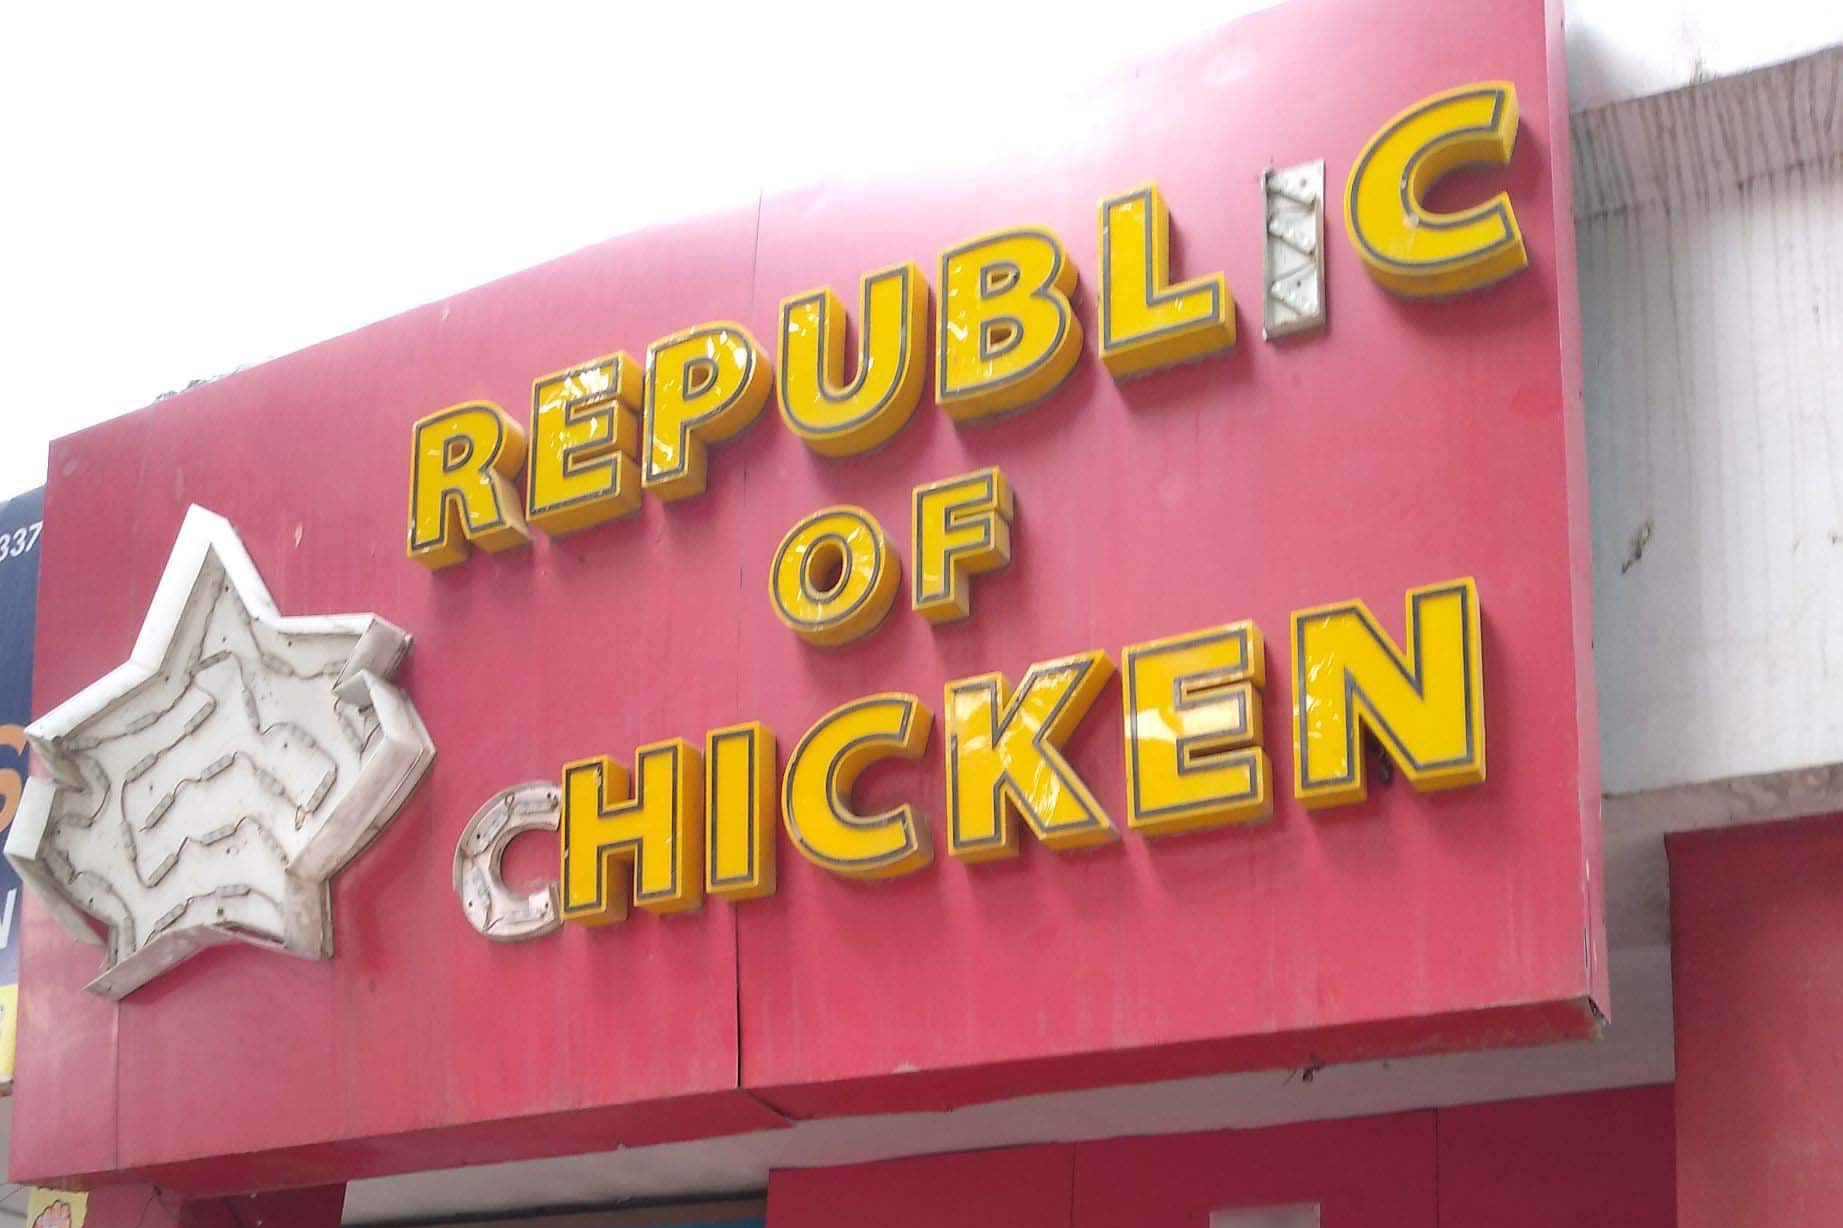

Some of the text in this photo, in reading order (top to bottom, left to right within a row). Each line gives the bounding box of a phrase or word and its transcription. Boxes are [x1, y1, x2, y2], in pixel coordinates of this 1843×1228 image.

[407, 80, 1528, 571] REPUBLIC
[769, 464, 1016, 646] OF
[452, 576, 1487, 942] CHICKEN
